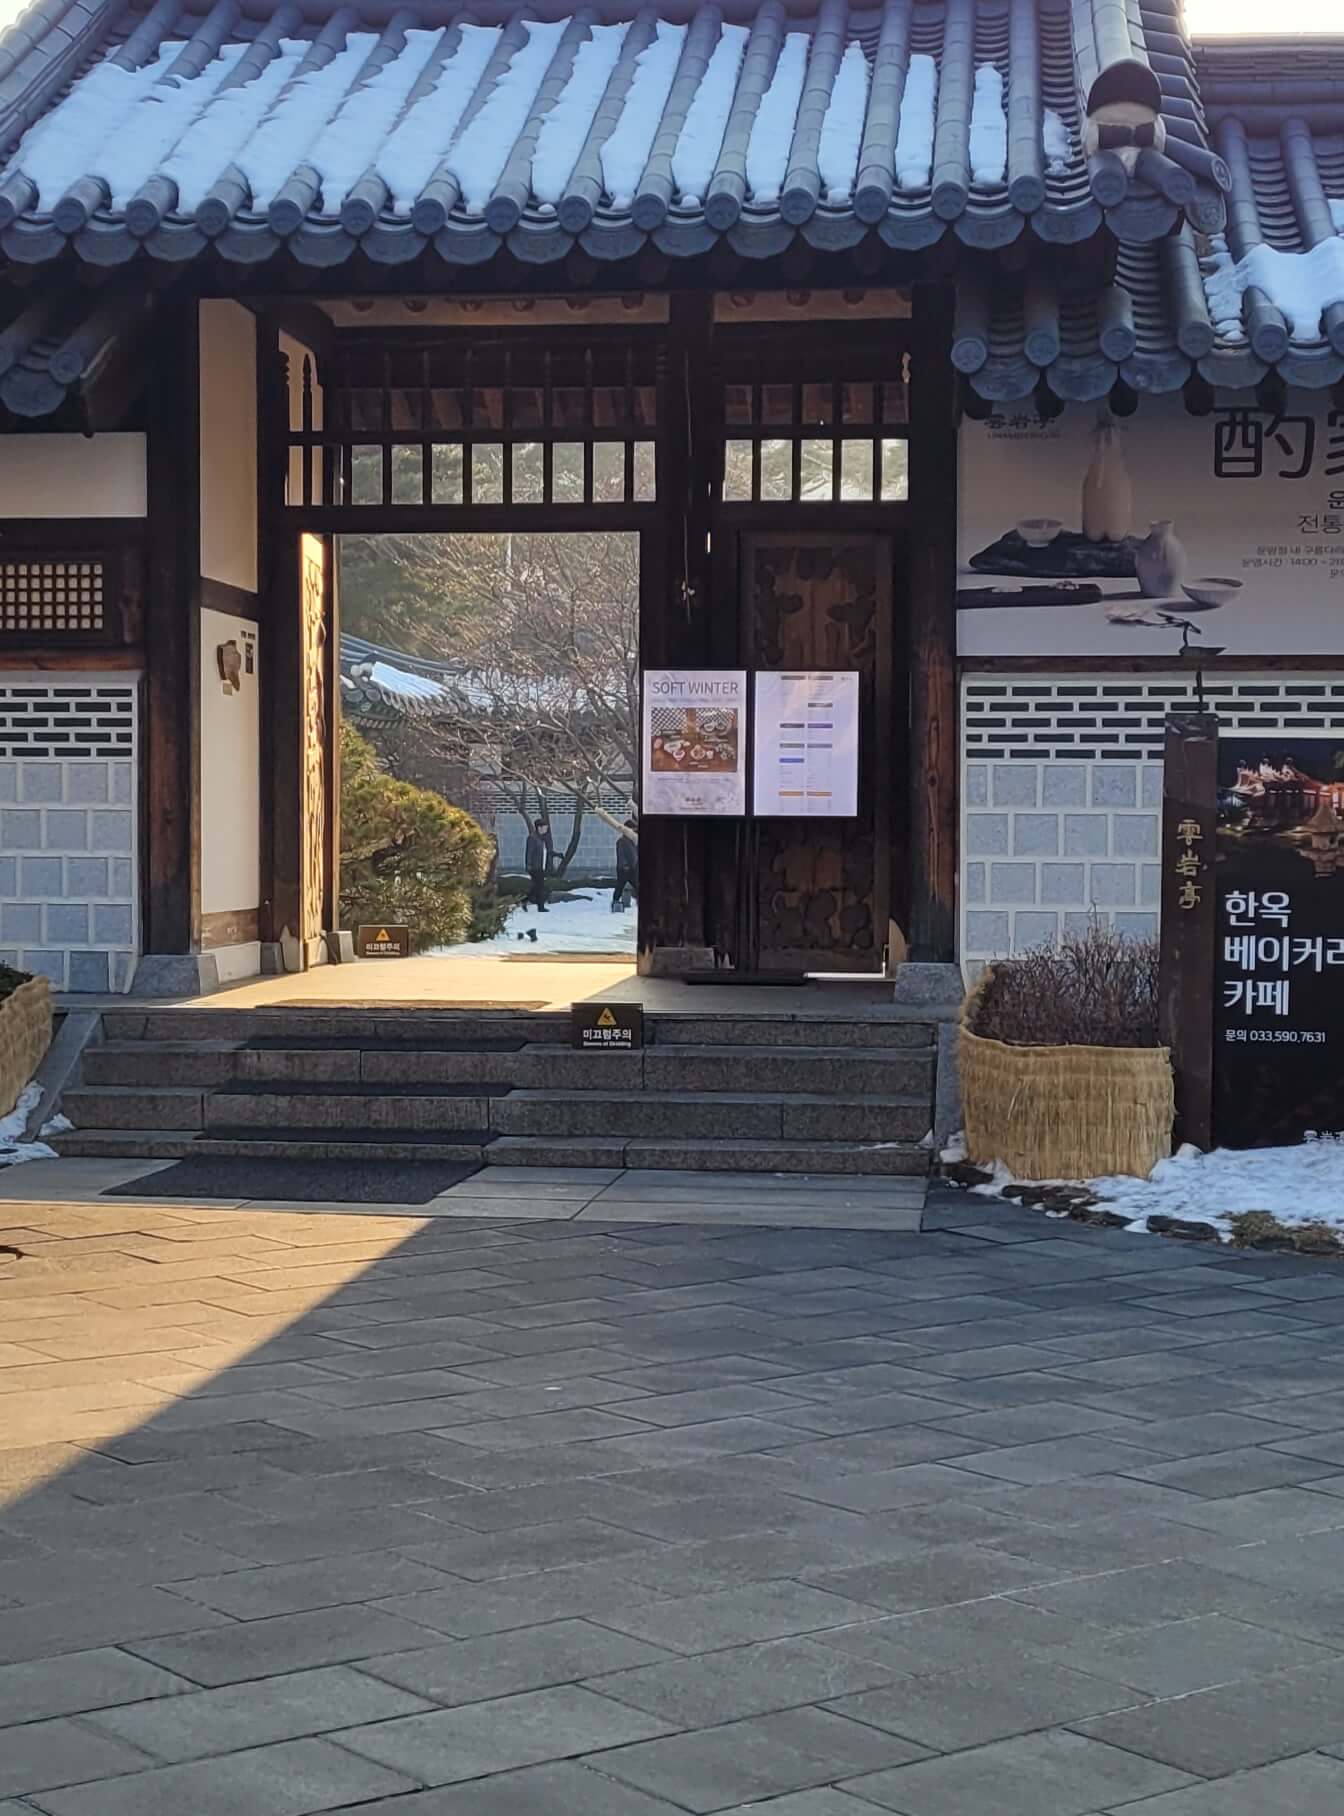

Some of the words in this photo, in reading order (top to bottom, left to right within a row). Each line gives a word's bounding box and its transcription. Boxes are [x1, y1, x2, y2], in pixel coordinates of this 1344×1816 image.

[652, 681, 686, 695] SOFT
[688, 681, 738, 695] WINTER
[1224, 890, 1292, 928] 한옥
[1223, 978, 1290, 1016] 카페
[1224, 1029, 1247, 1042] 문의
